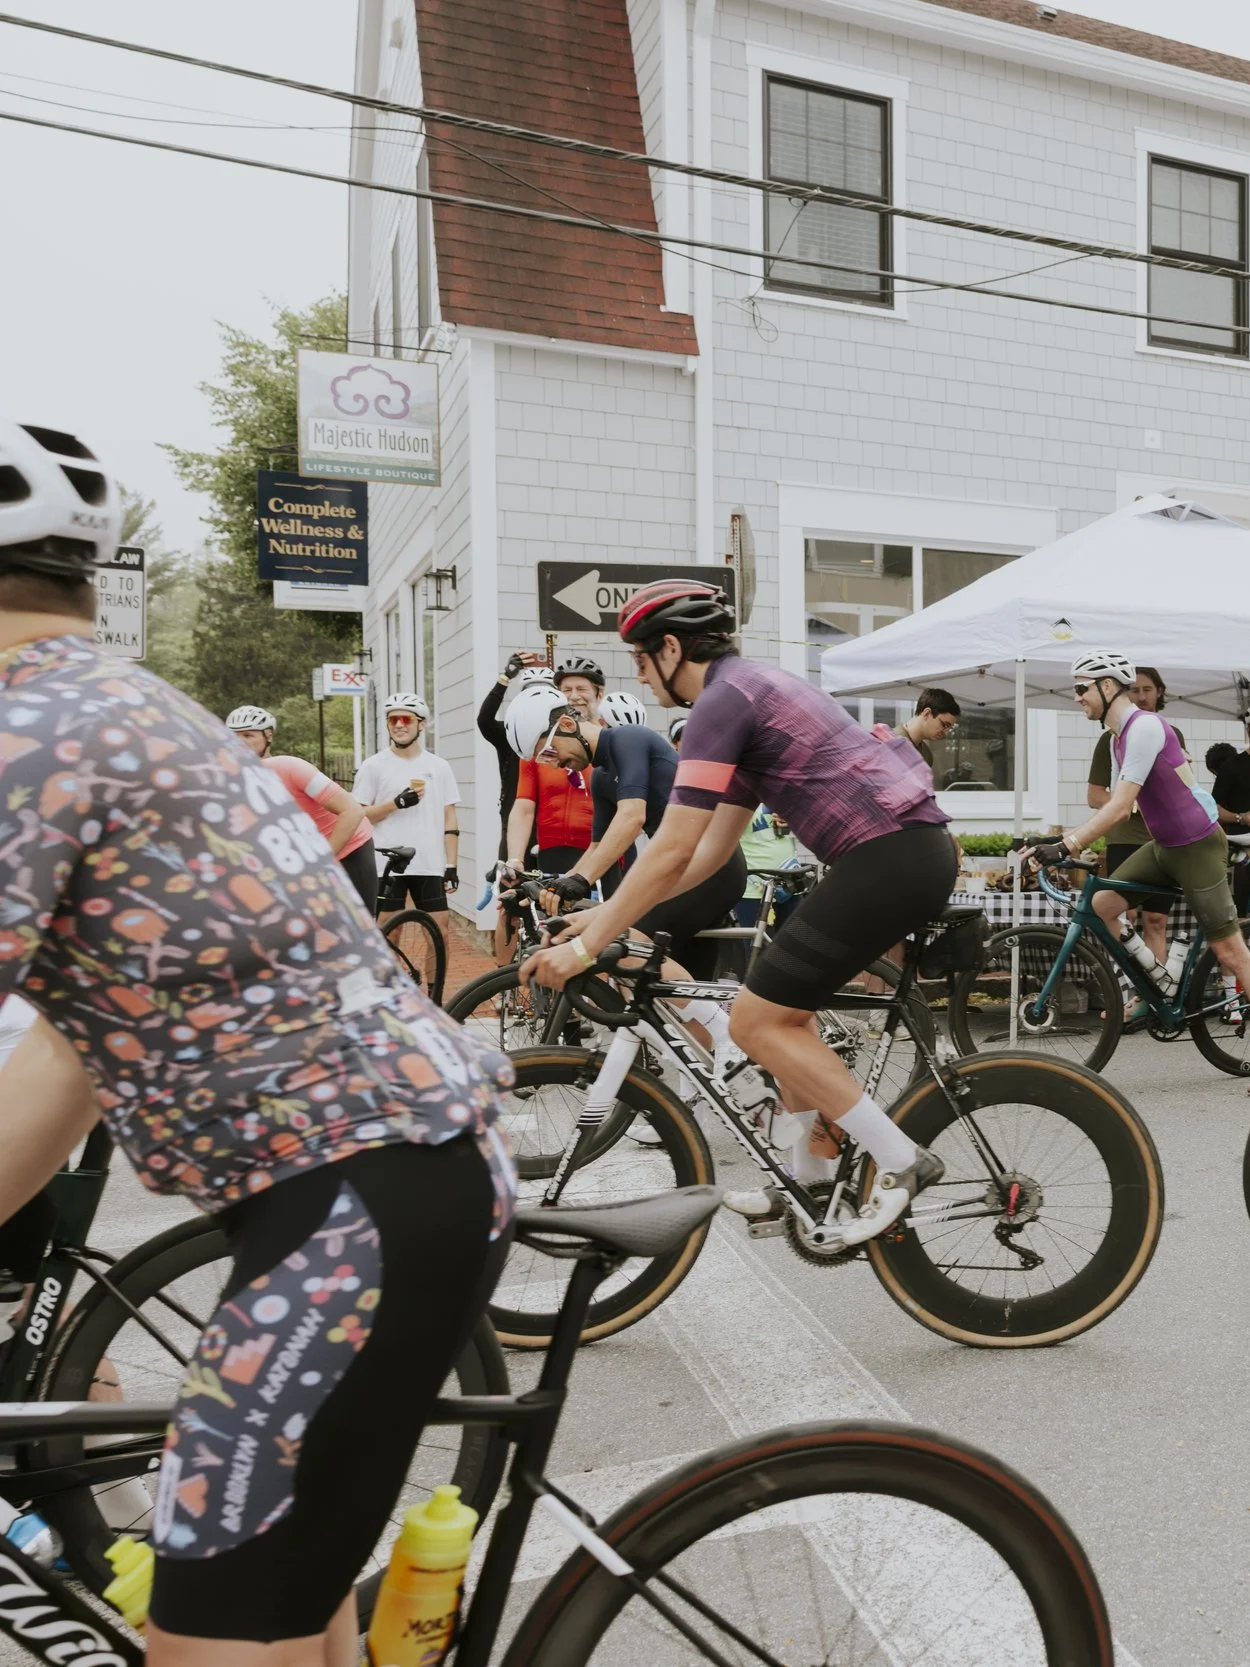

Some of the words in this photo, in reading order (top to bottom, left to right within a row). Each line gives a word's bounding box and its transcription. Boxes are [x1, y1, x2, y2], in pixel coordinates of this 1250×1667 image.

[314, 422, 373, 449] Majestic
[378, 428, 429, 454] Hudson
[305, 463, 371, 475] LIFESTYLE
[375, 470, 436, 481] BOUTIQUE
[268, 497, 357, 519] Complete
[260, 517, 344, 539] Wellness
[347, 524, 365, 540] &
[268, 538, 358, 560] Nutrition
[119, 577, 134, 591] TO
[100, 592, 140, 609] TRIANS
[595, 587, 638, 608] ON
[95, 631, 139, 646] SWALK
[672, 986, 740, 1000] SUPER
[25, 1276, 62, 1346] OSTRO
